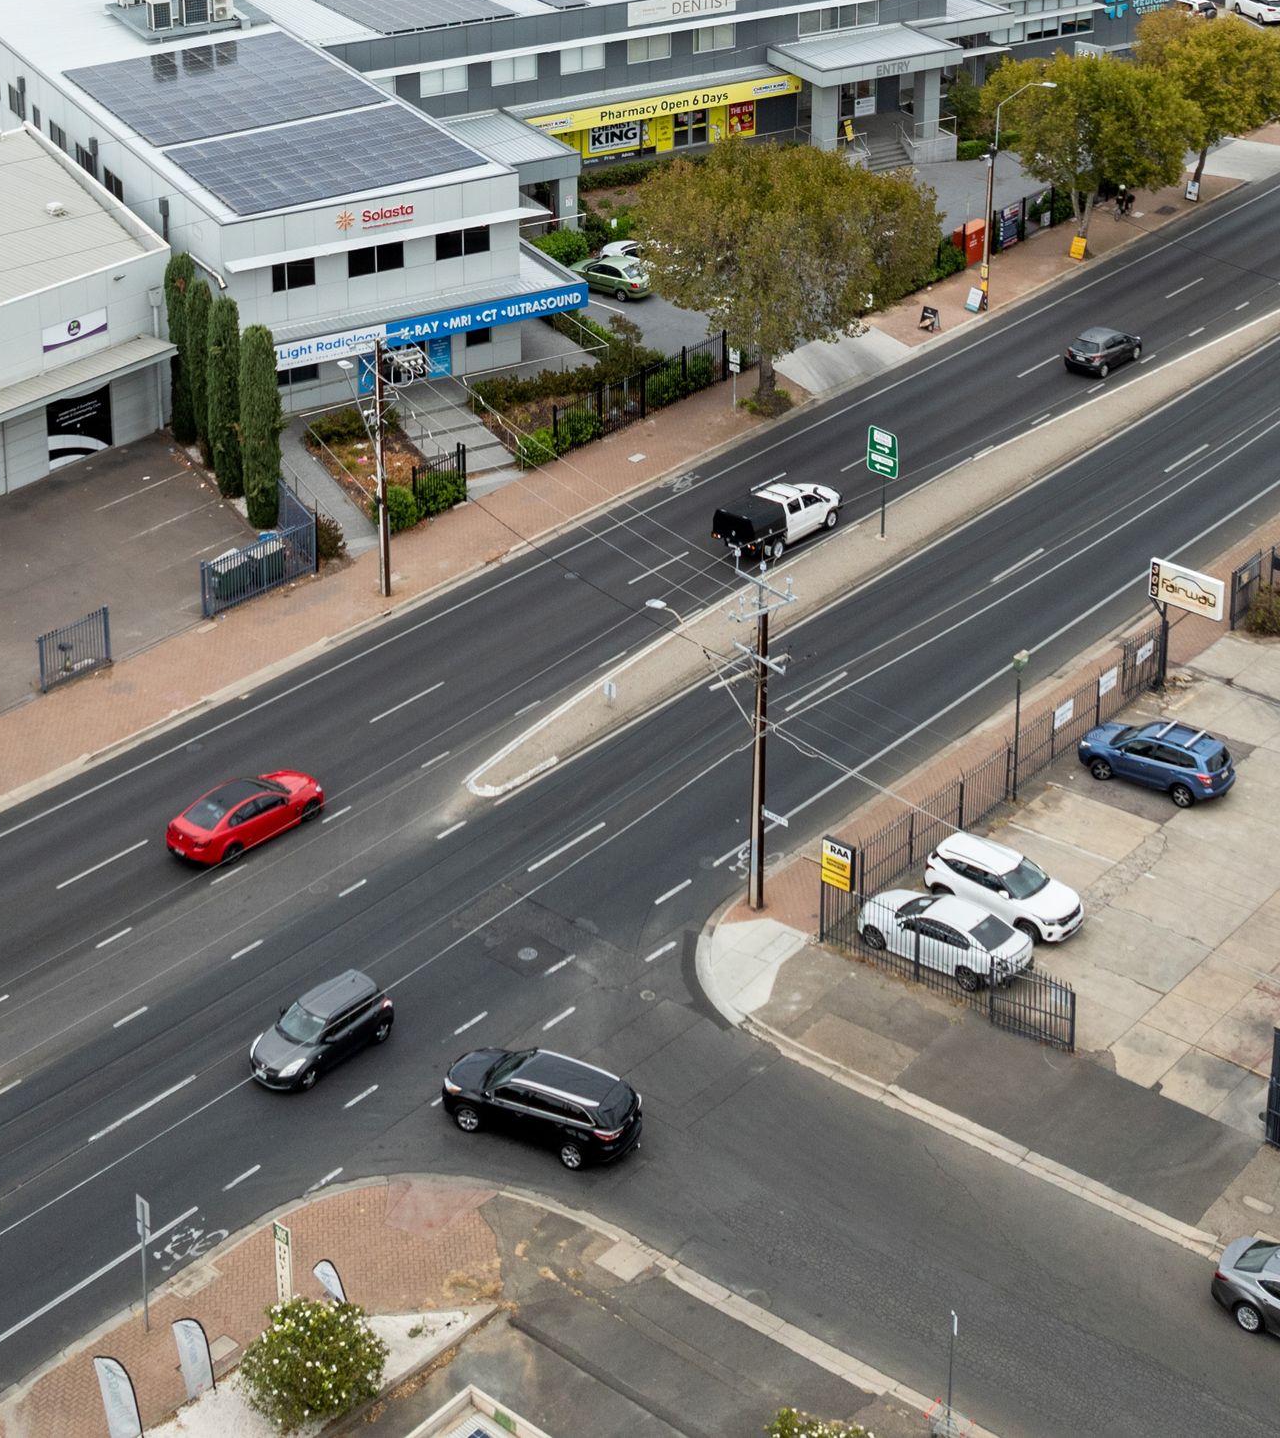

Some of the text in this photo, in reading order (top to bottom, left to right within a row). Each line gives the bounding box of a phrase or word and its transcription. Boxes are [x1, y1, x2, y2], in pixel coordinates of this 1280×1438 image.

[876, 59, 911, 77] ENTRY
[600, 90, 729, 122] Pharmacy Open 6 Days
[730, 104, 754, 115] THE FLU
[591, 121, 631, 134] CHEMIST
[591, 127, 638, 147] KING
[362, 204, 414, 223] Solasta
[449, 315, 472, 330] MRI
[481, 308, 497, 323] CT
[506, 292, 582, 318] ULTRASOUND
[279, 345, 313, 361] Light
[316, 331, 381, 352] Radiology
[1161, 577, 1216, 608] Fairway
[830, 844, 849, 860] RAA
